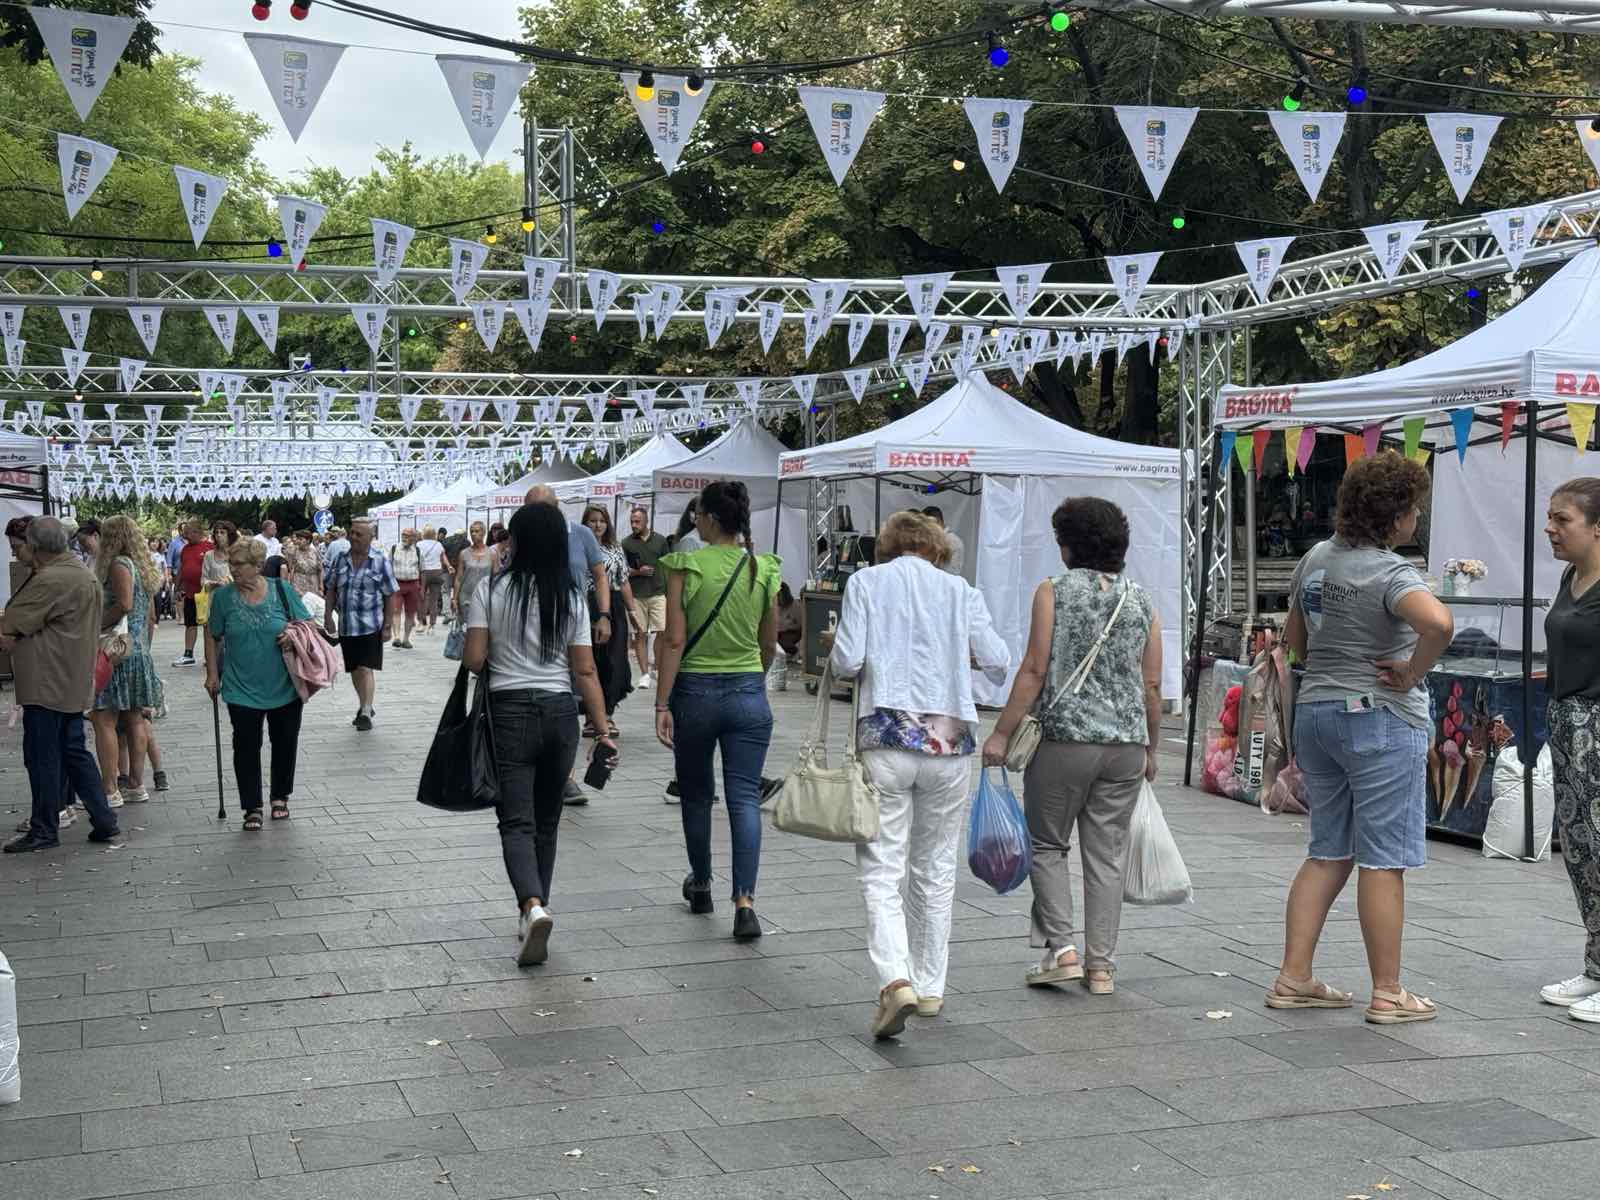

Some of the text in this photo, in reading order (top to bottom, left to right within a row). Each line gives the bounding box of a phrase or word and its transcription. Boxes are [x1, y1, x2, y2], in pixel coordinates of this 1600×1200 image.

[1225, 393, 1292, 418] BAGIRA
[889, 451, 970, 468] BAGIRA
[1113, 464, 1180, 473] www.bagira.b
[661, 477, 720, 489] BAGIR
